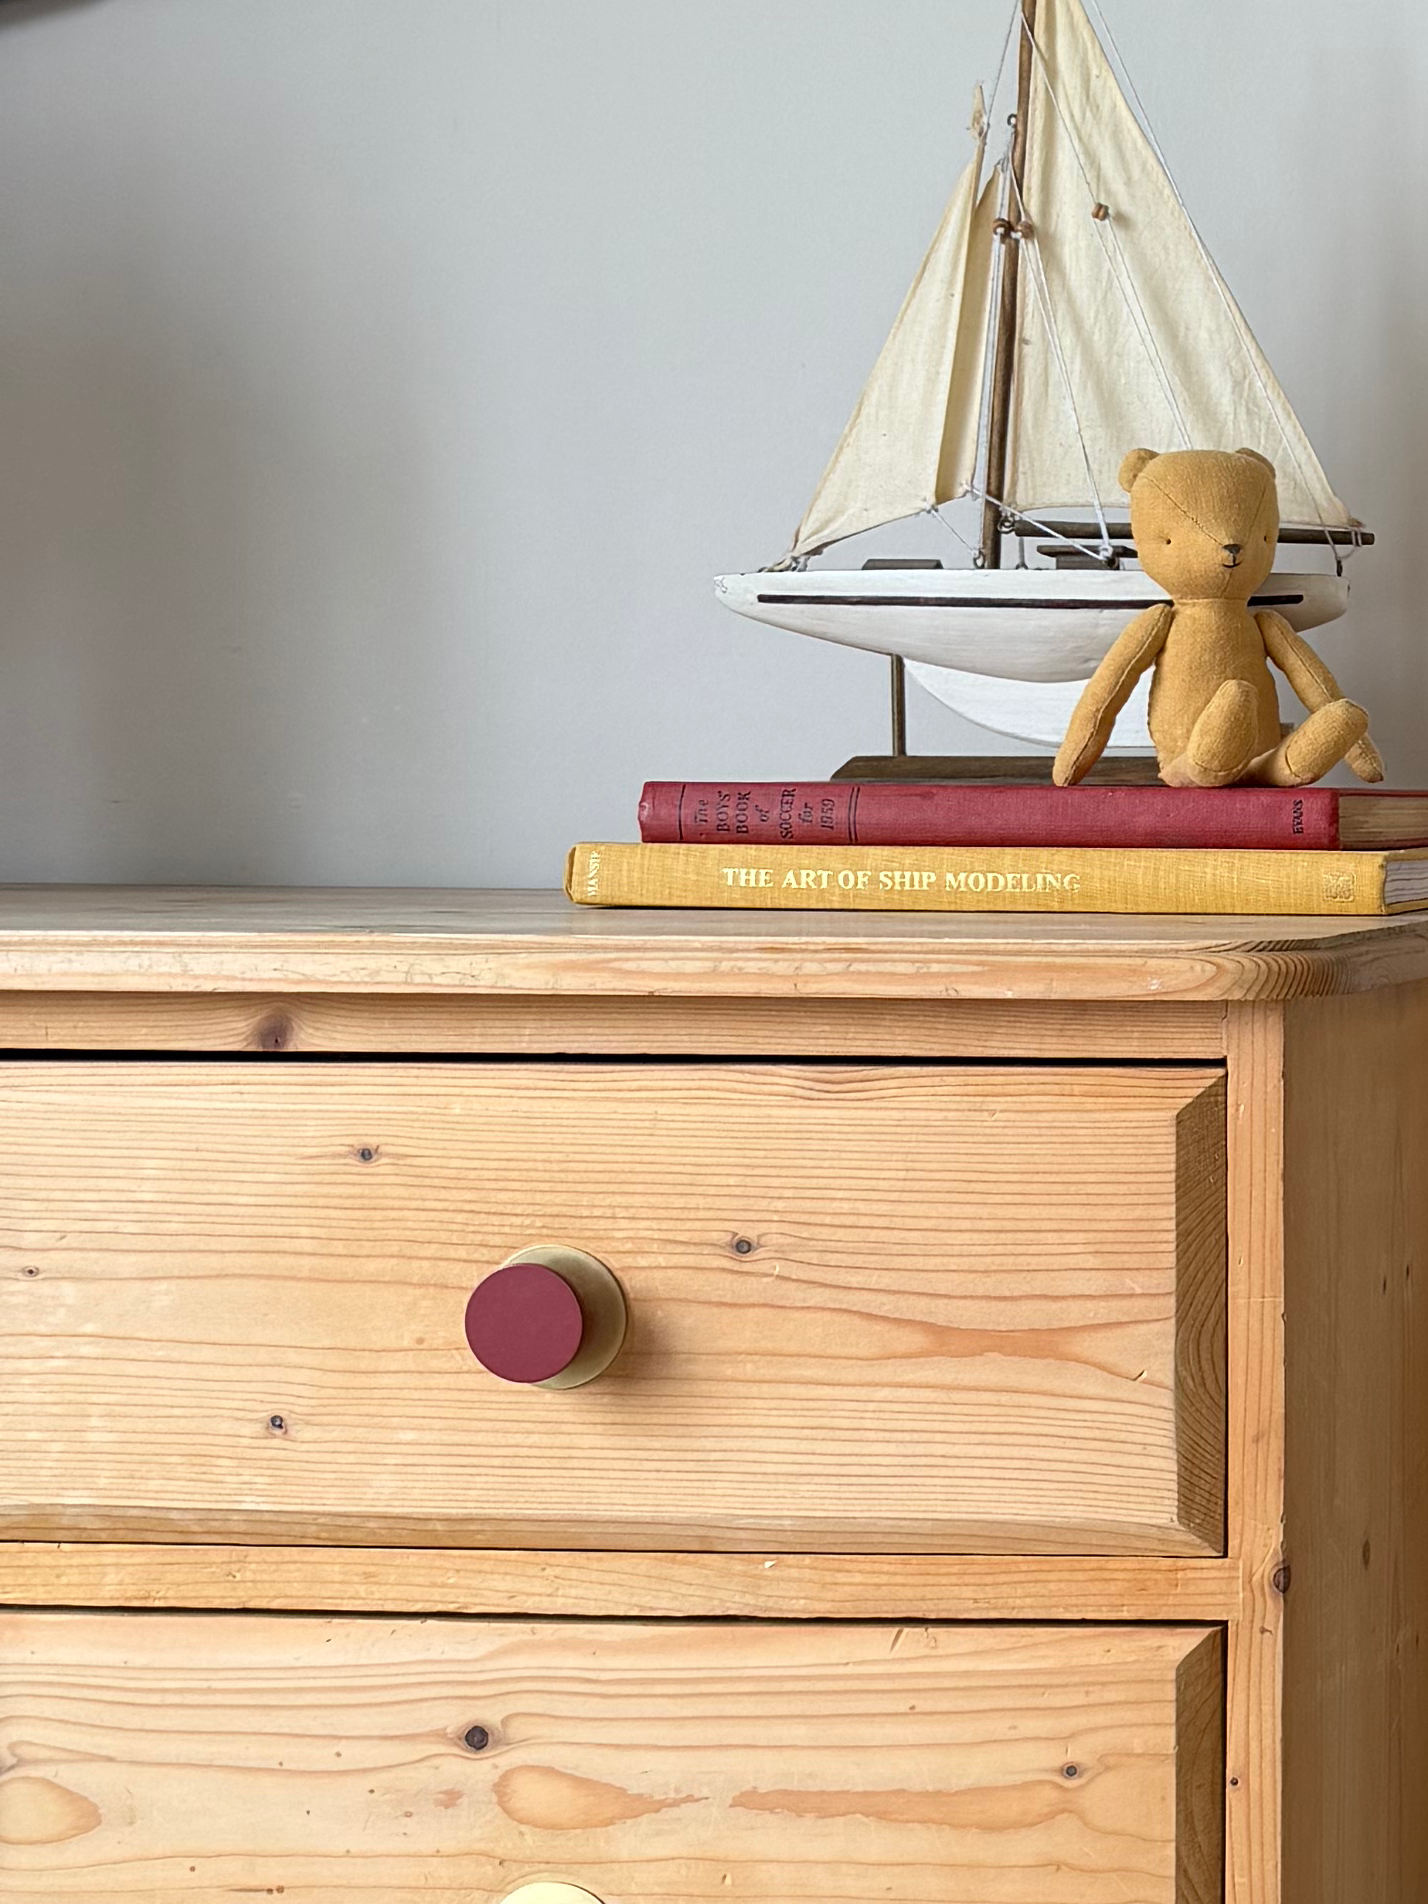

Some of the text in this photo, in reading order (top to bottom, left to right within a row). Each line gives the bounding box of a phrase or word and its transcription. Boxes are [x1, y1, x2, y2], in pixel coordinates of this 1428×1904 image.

[694, 799, 709, 824] The
[735, 791, 751, 834] BOOK
[755, 804, 770, 823] of
[779, 788, 797, 840] SOCCER
[798, 802, 814, 824] for
[820, 798, 836, 831] 1959
[723, 867, 1082, 894] THE ART OF SHIP MODELING
